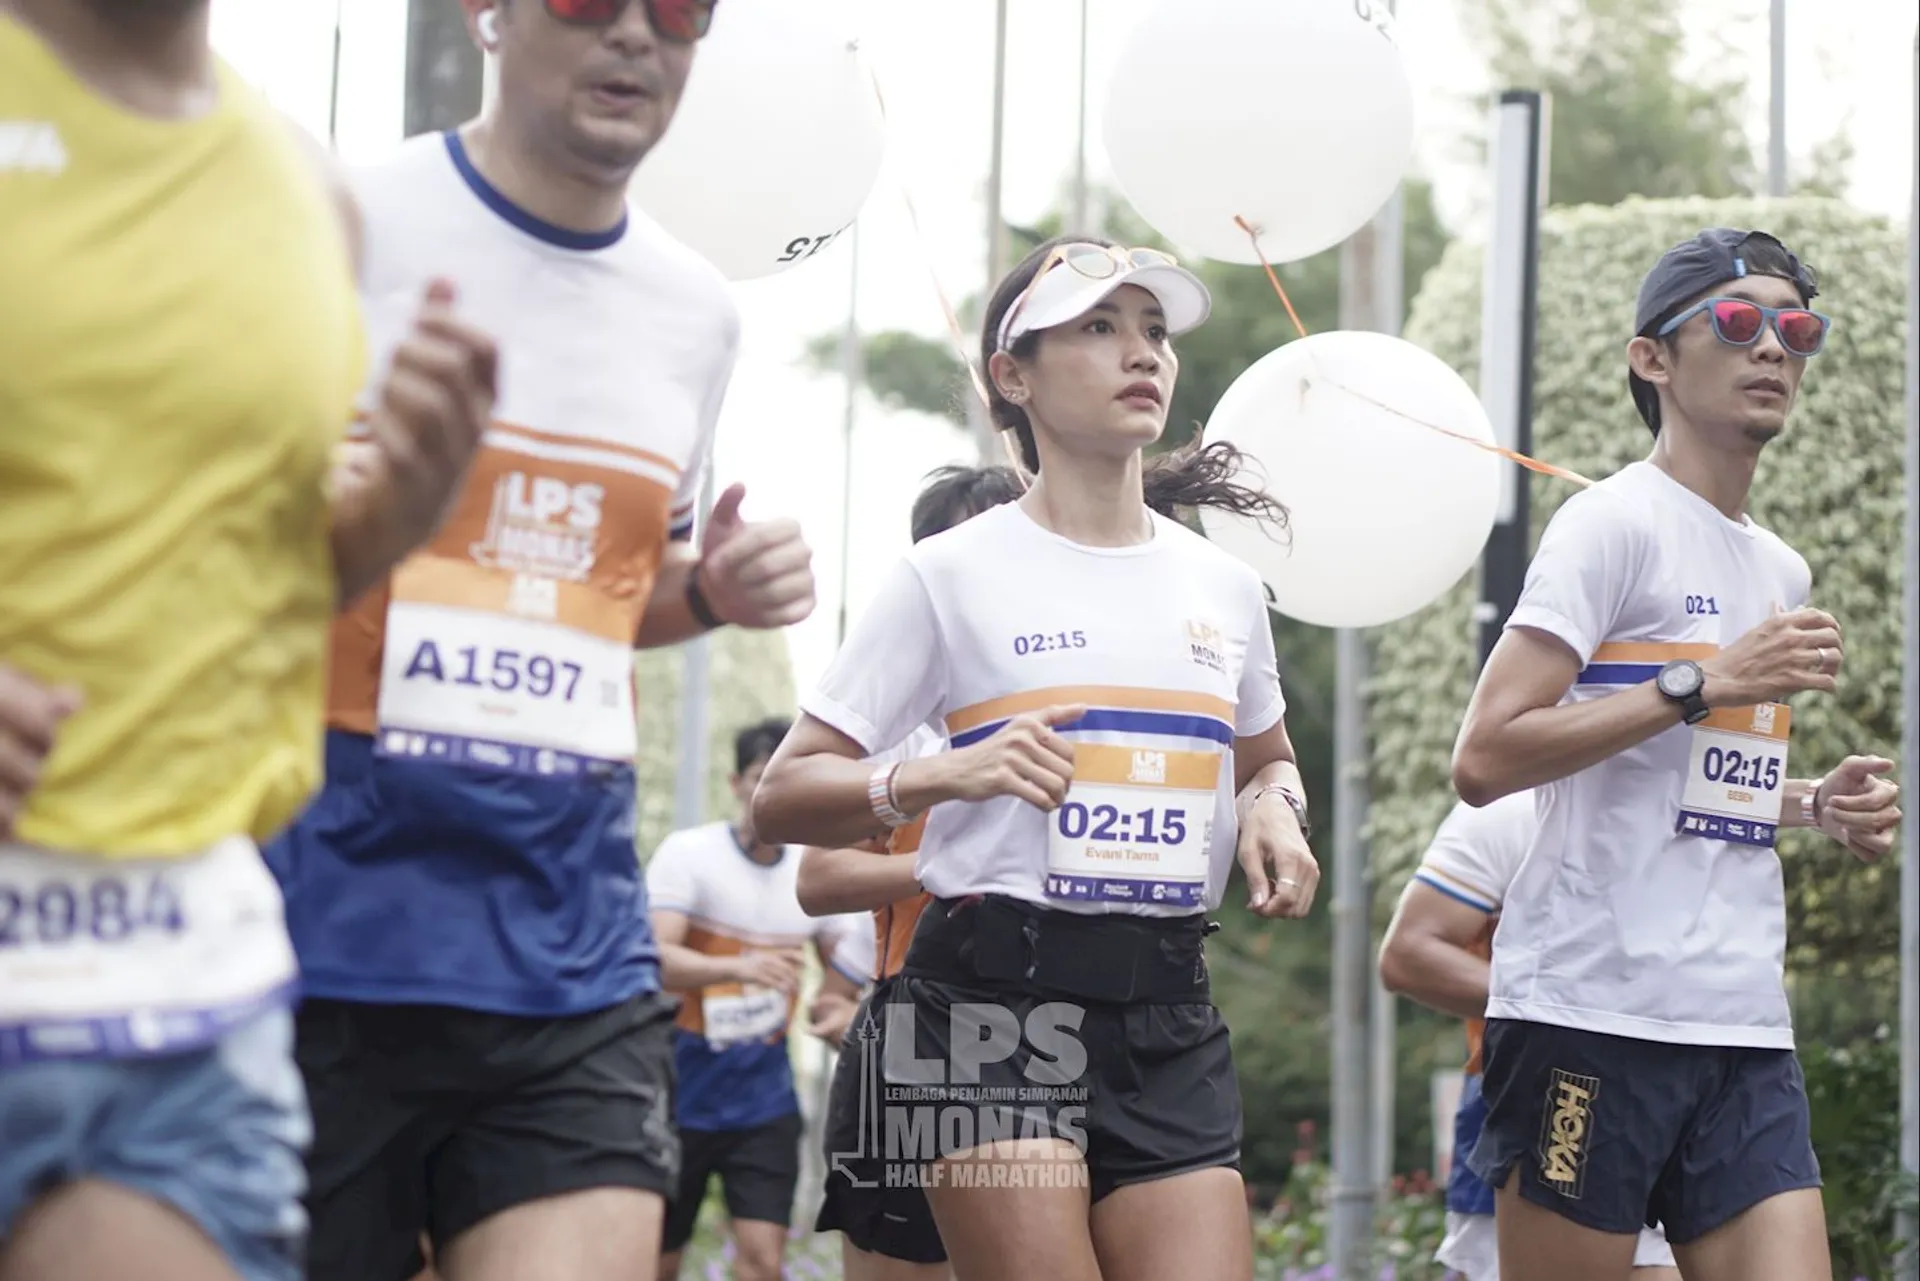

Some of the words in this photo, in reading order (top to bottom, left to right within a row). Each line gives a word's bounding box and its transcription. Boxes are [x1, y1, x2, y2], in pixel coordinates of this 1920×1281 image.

[507, 470, 606, 528] LPS
[1685, 595, 1720, 615] 021
[1013, 630, 1087, 656] 02:15
[403, 638, 583, 702] A1597
[1703, 746, 1781, 791] 02:15
[1058, 801, 1186, 845] 02:15
[1085, 846, 1122, 860] Evani
[1124, 849, 1160, 862] Tama
[1545, 1080, 1589, 1182] HOKA
